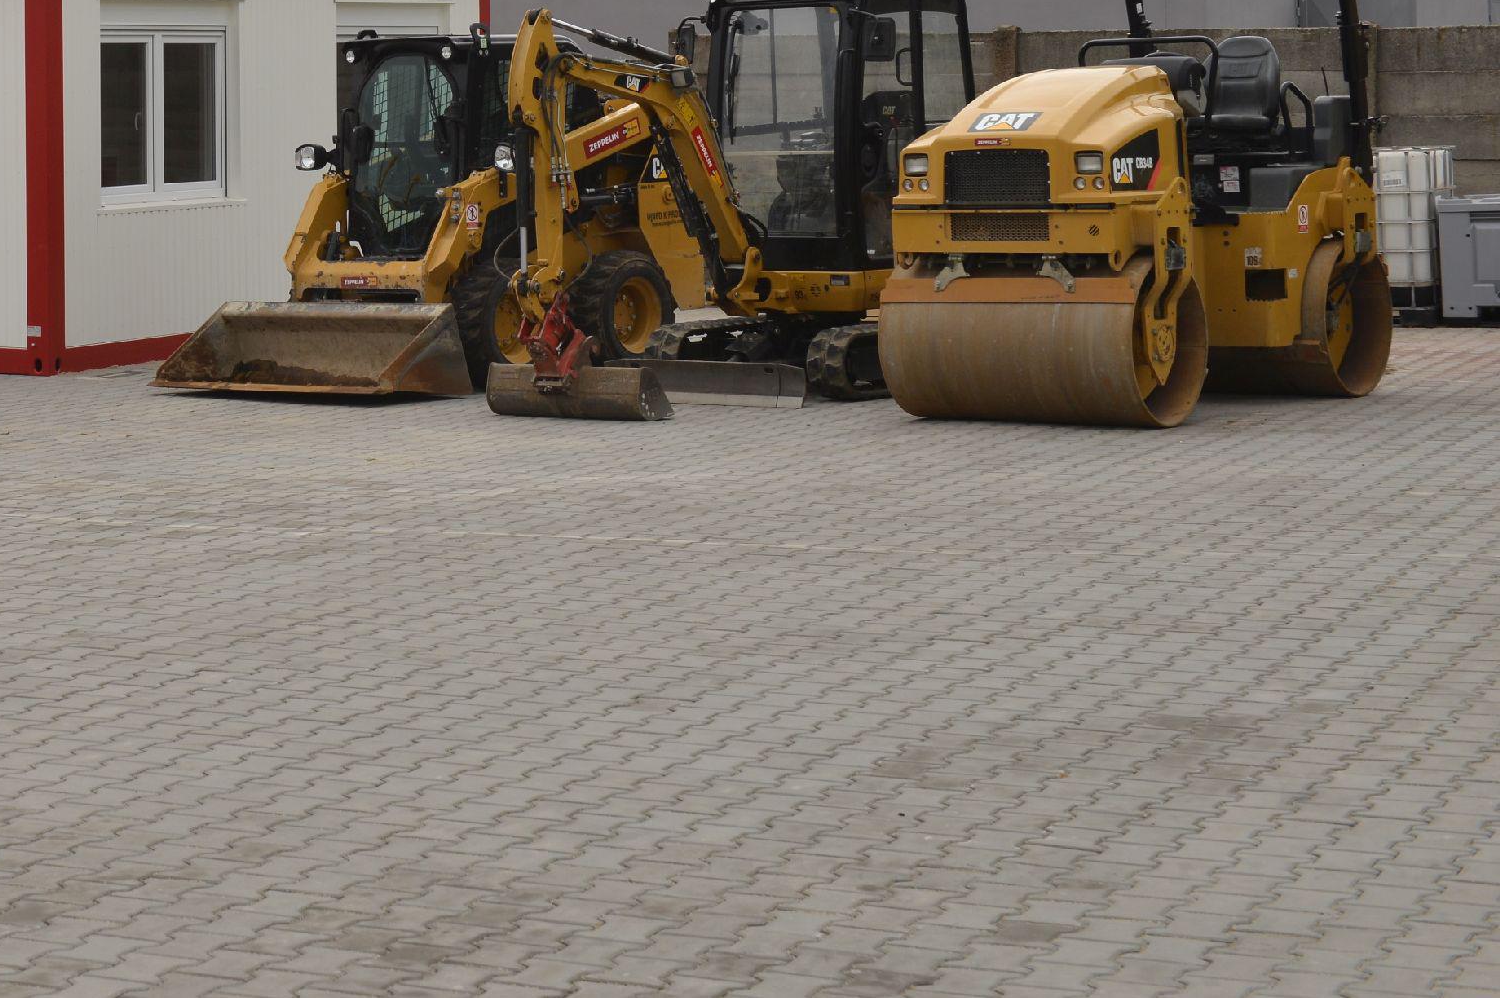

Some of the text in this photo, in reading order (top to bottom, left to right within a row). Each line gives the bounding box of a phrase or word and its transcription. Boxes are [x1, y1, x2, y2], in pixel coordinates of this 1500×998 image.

[626, 75, 641, 92] CAT
[974, 112, 1036, 131] CAT
[588, 131, 620, 154] ZEPPELIN
[1112, 157, 1134, 184] CAT
